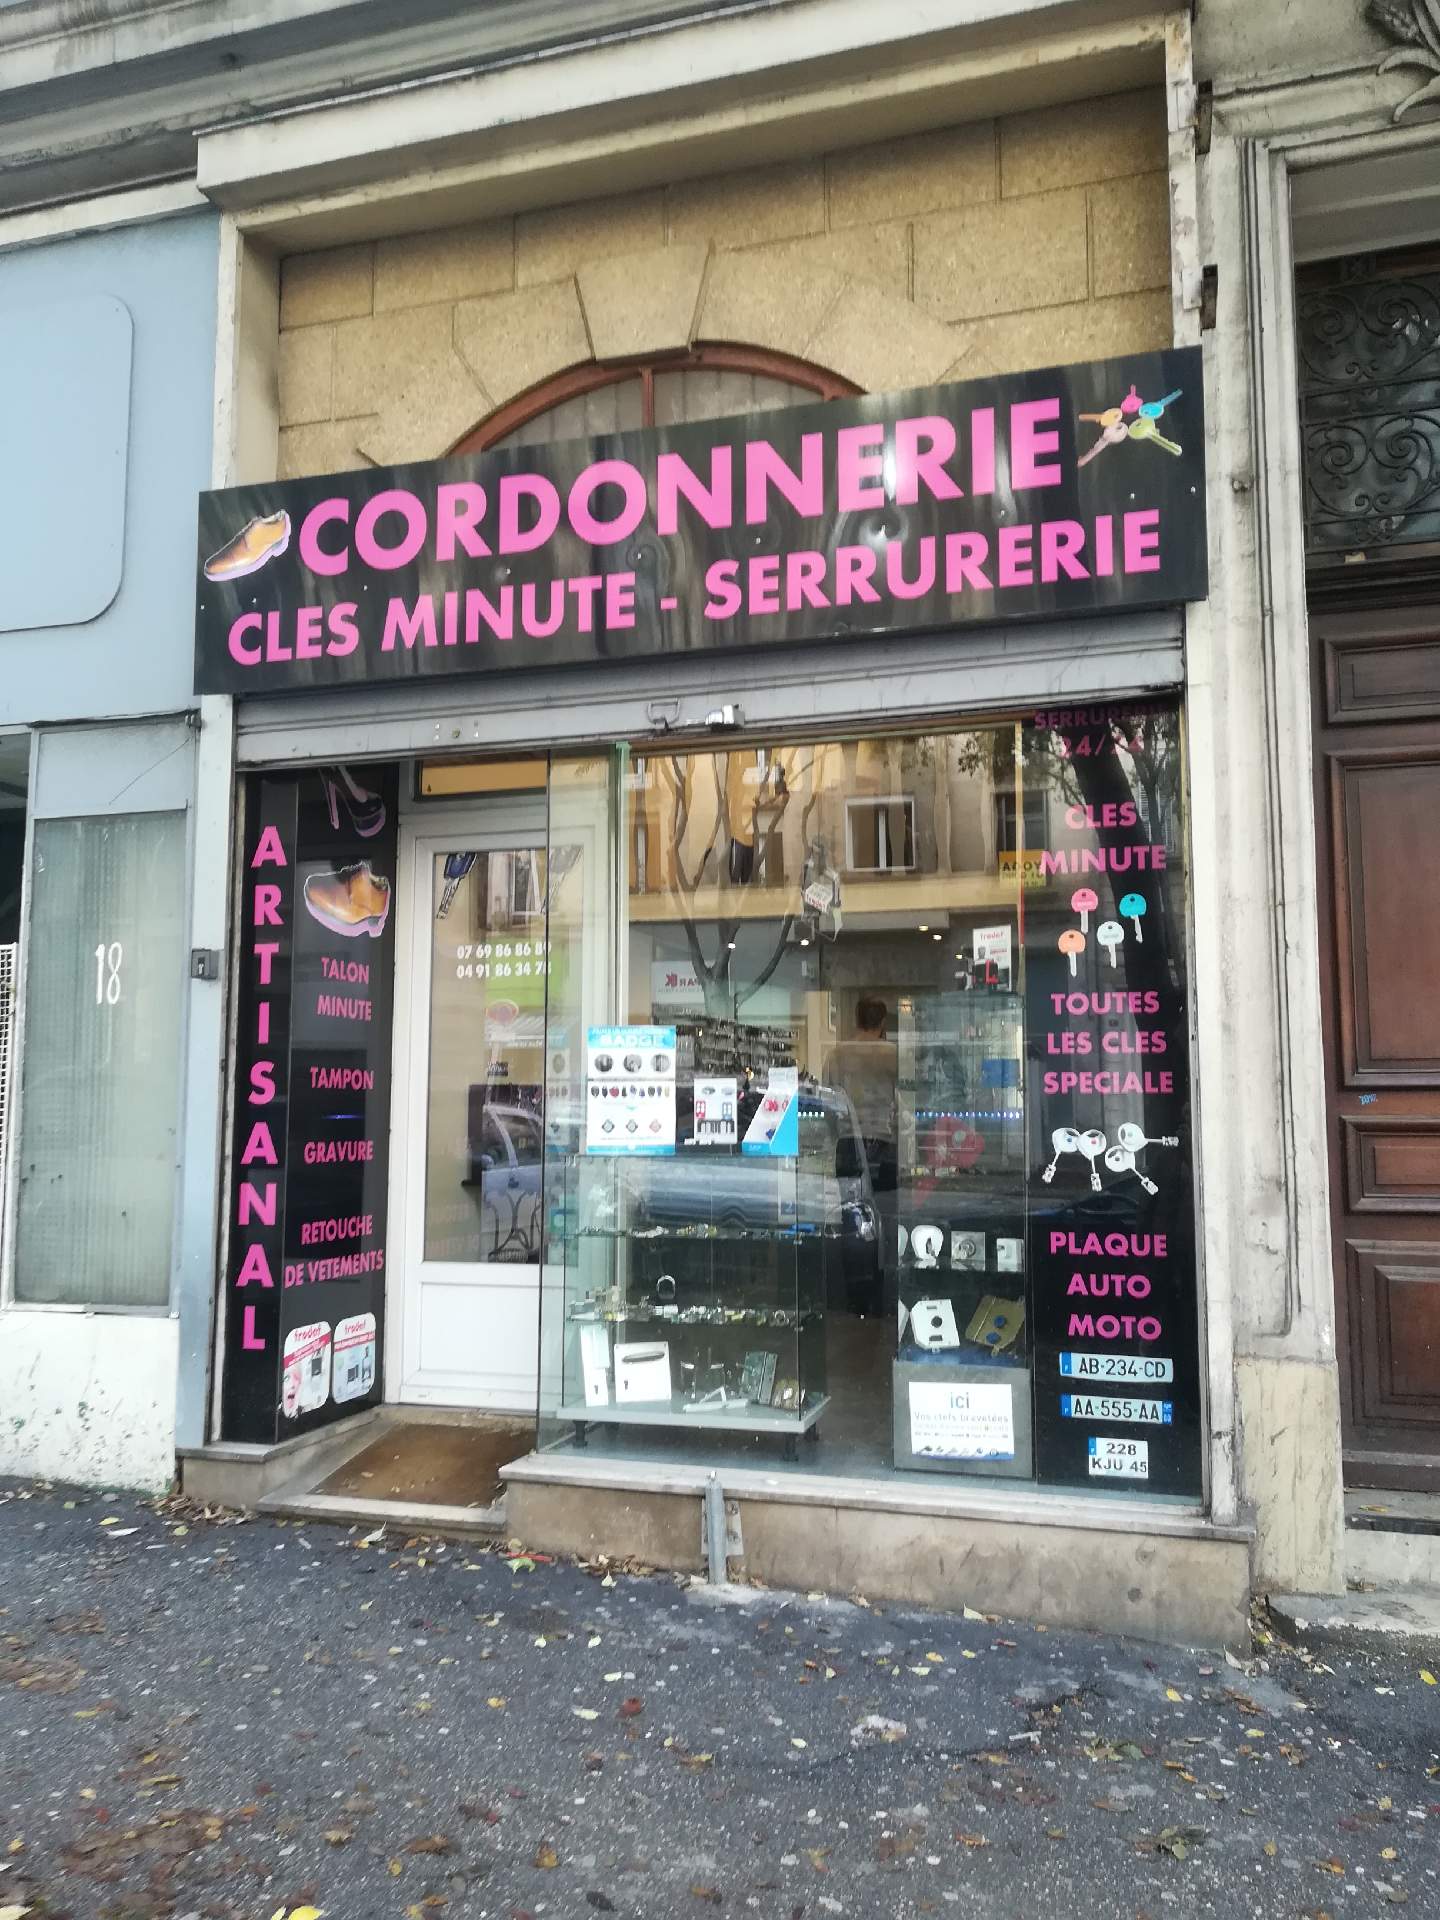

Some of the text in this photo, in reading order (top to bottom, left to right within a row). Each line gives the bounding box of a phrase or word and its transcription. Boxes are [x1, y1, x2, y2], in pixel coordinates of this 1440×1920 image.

[299, 397, 1062, 576] CORDONNERIE
[228, 509, 1161, 666] CLES MINUTE - SERRURERIE
[1064, 802, 1137, 829] CLES
[1040, 845, 1167, 875] MINUTE
[457, 945, 472, 959] 07
[476, 944, 492, 958] 69
[96, 942, 122, 1004] 18
[320, 957, 369, 984] TALON
[457, 965, 472, 978] 04
[476, 964, 490, 978] 91
[316, 995, 372, 1021] MINUTE
[1051, 992, 1160, 1015] TOUTES
[1047, 1031, 1167, 1054] LES CLES
[235, 826, 288, 1350] ARTISANAL
[310, 1066, 374, 1090] TAMPON
[1043, 1072, 1174, 1094] SPECIALE
[304, 1140, 374, 1164] GRAVURE
[301, 1215, 373, 1245] RETOUCHE
[1050, 1232, 1168, 1257] PLAQUE
[284, 1249, 384, 1289] DE VETEMENTS
[1066, 1273, 1151, 1298] AUTO
[1068, 1314, 1162, 1340] MOTO
[1079, 1357, 1166, 1378] AB-234-CD
[1074, 1398, 1160, 1421] AA-555-AA
[1106, 1443, 1137, 1456] 228
[1092, 1457, 1148, 1473] KJU 45
